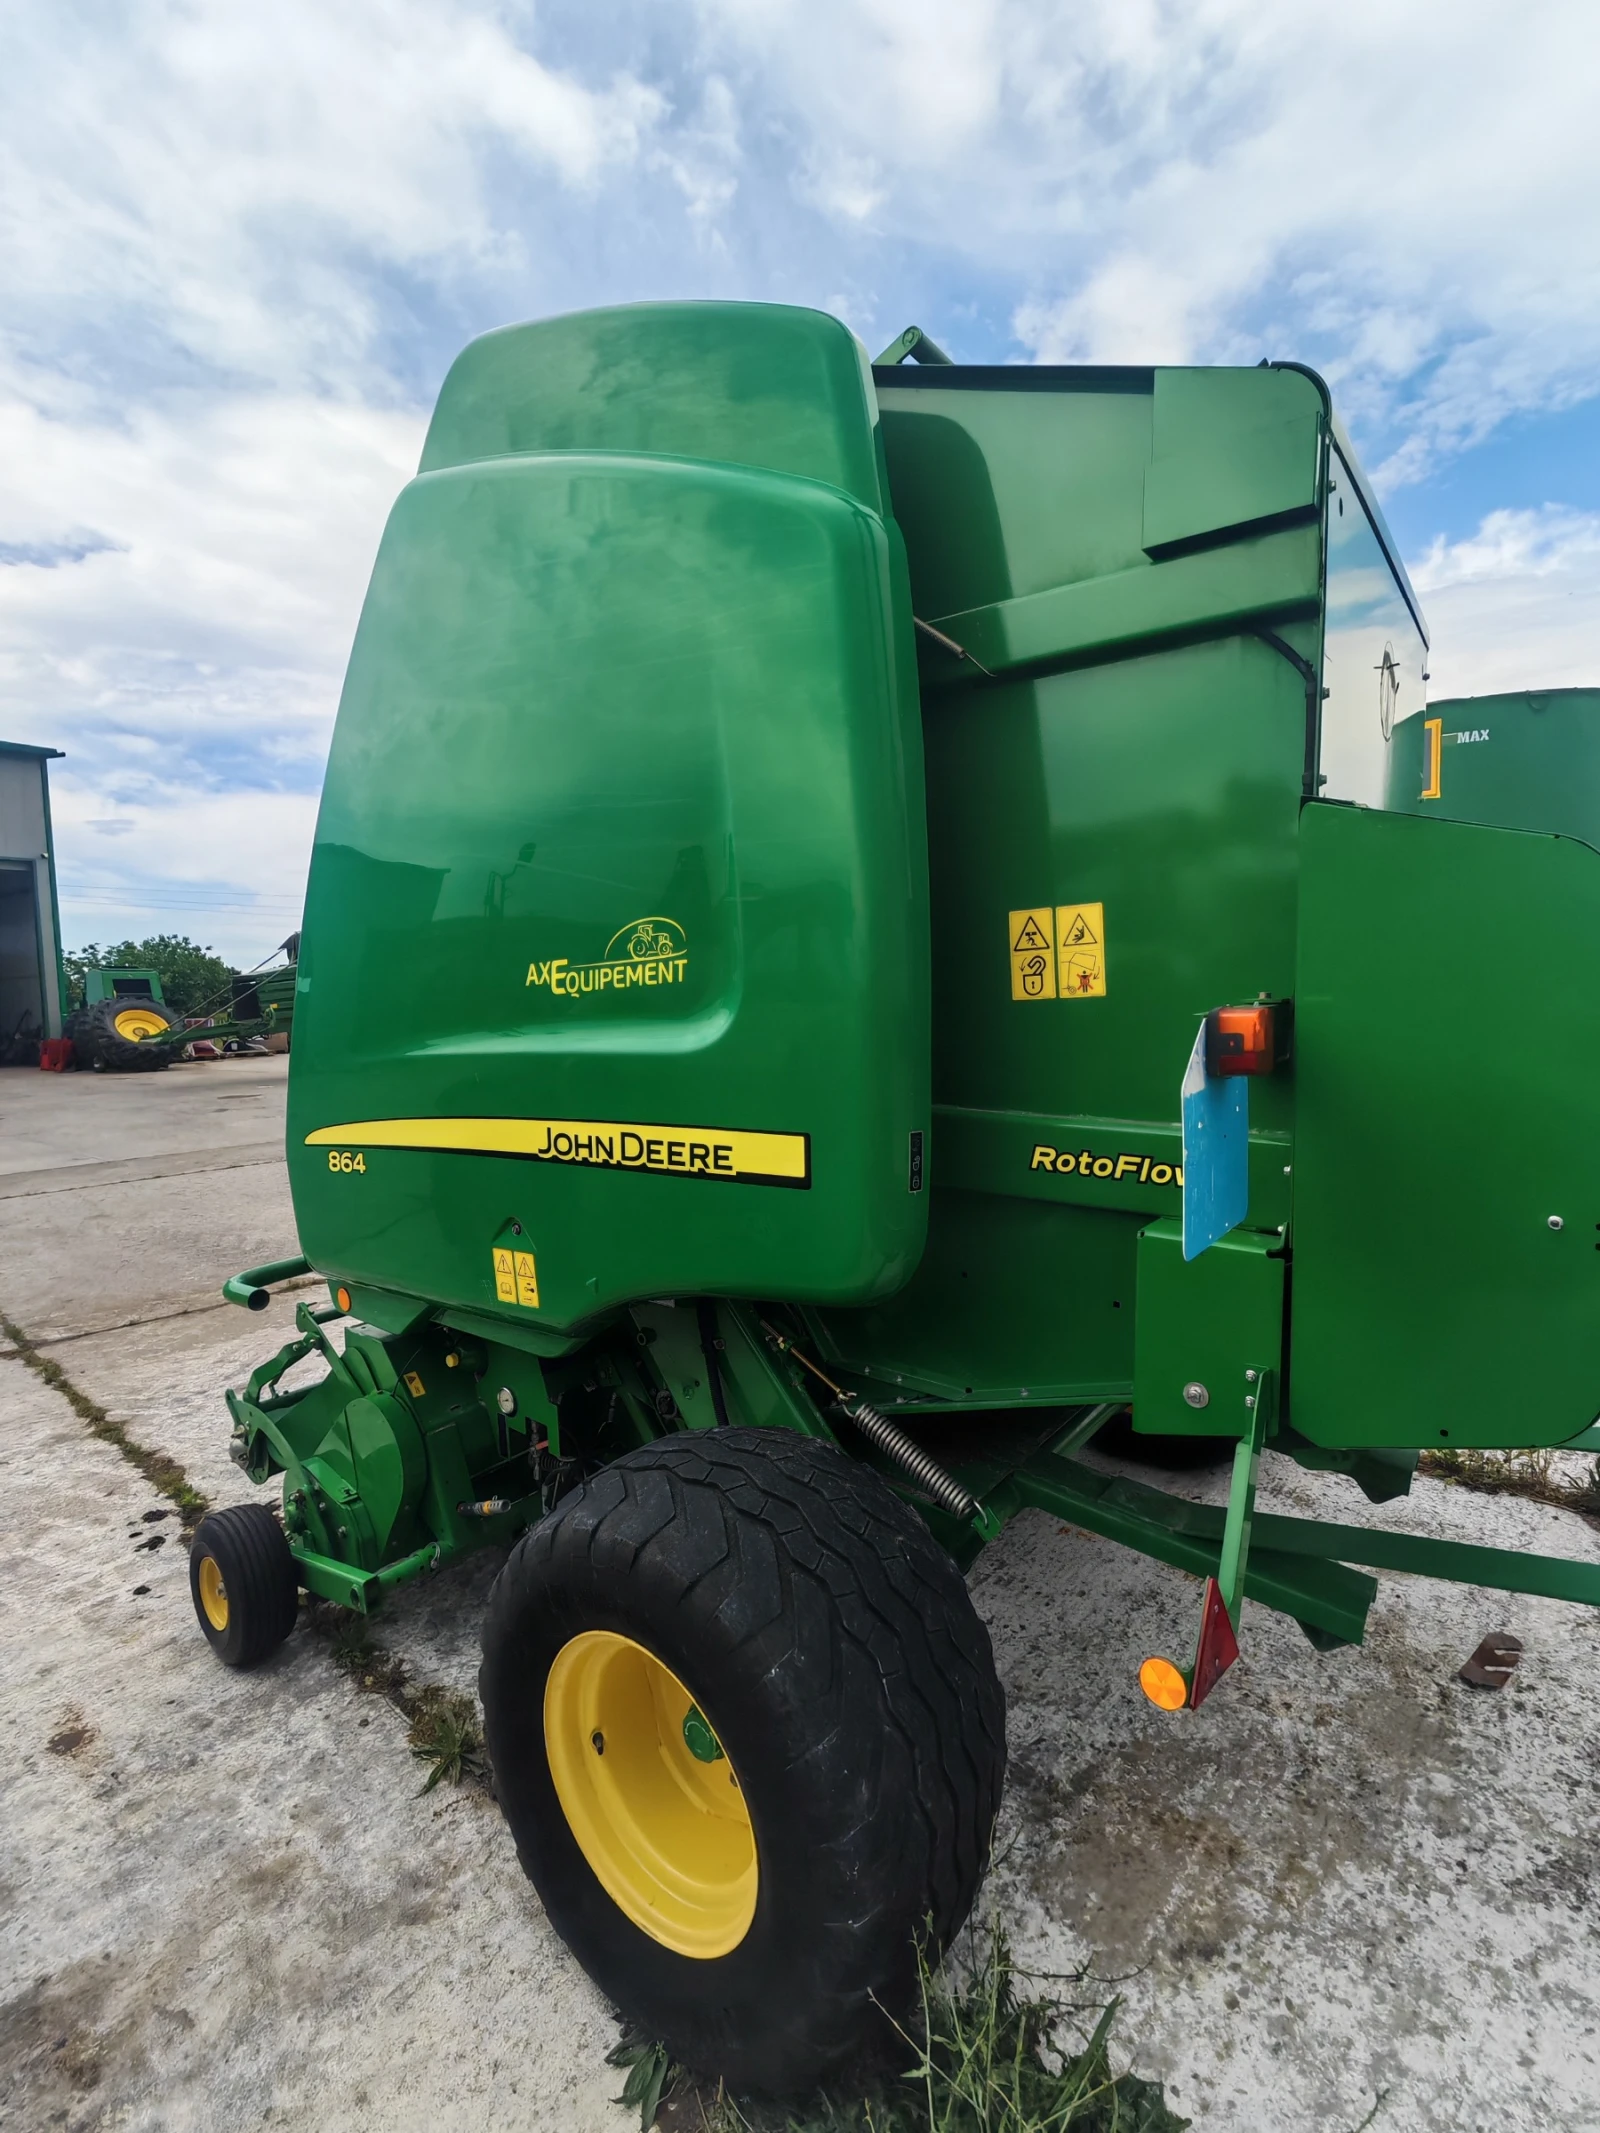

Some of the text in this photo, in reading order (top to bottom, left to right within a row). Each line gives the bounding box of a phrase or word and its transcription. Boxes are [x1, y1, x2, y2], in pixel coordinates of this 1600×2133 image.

[1457, 729, 1490, 744] MAX
[328, 1150, 366, 1174] 864
[538, 1127, 735, 1173] JOHN DEERE
